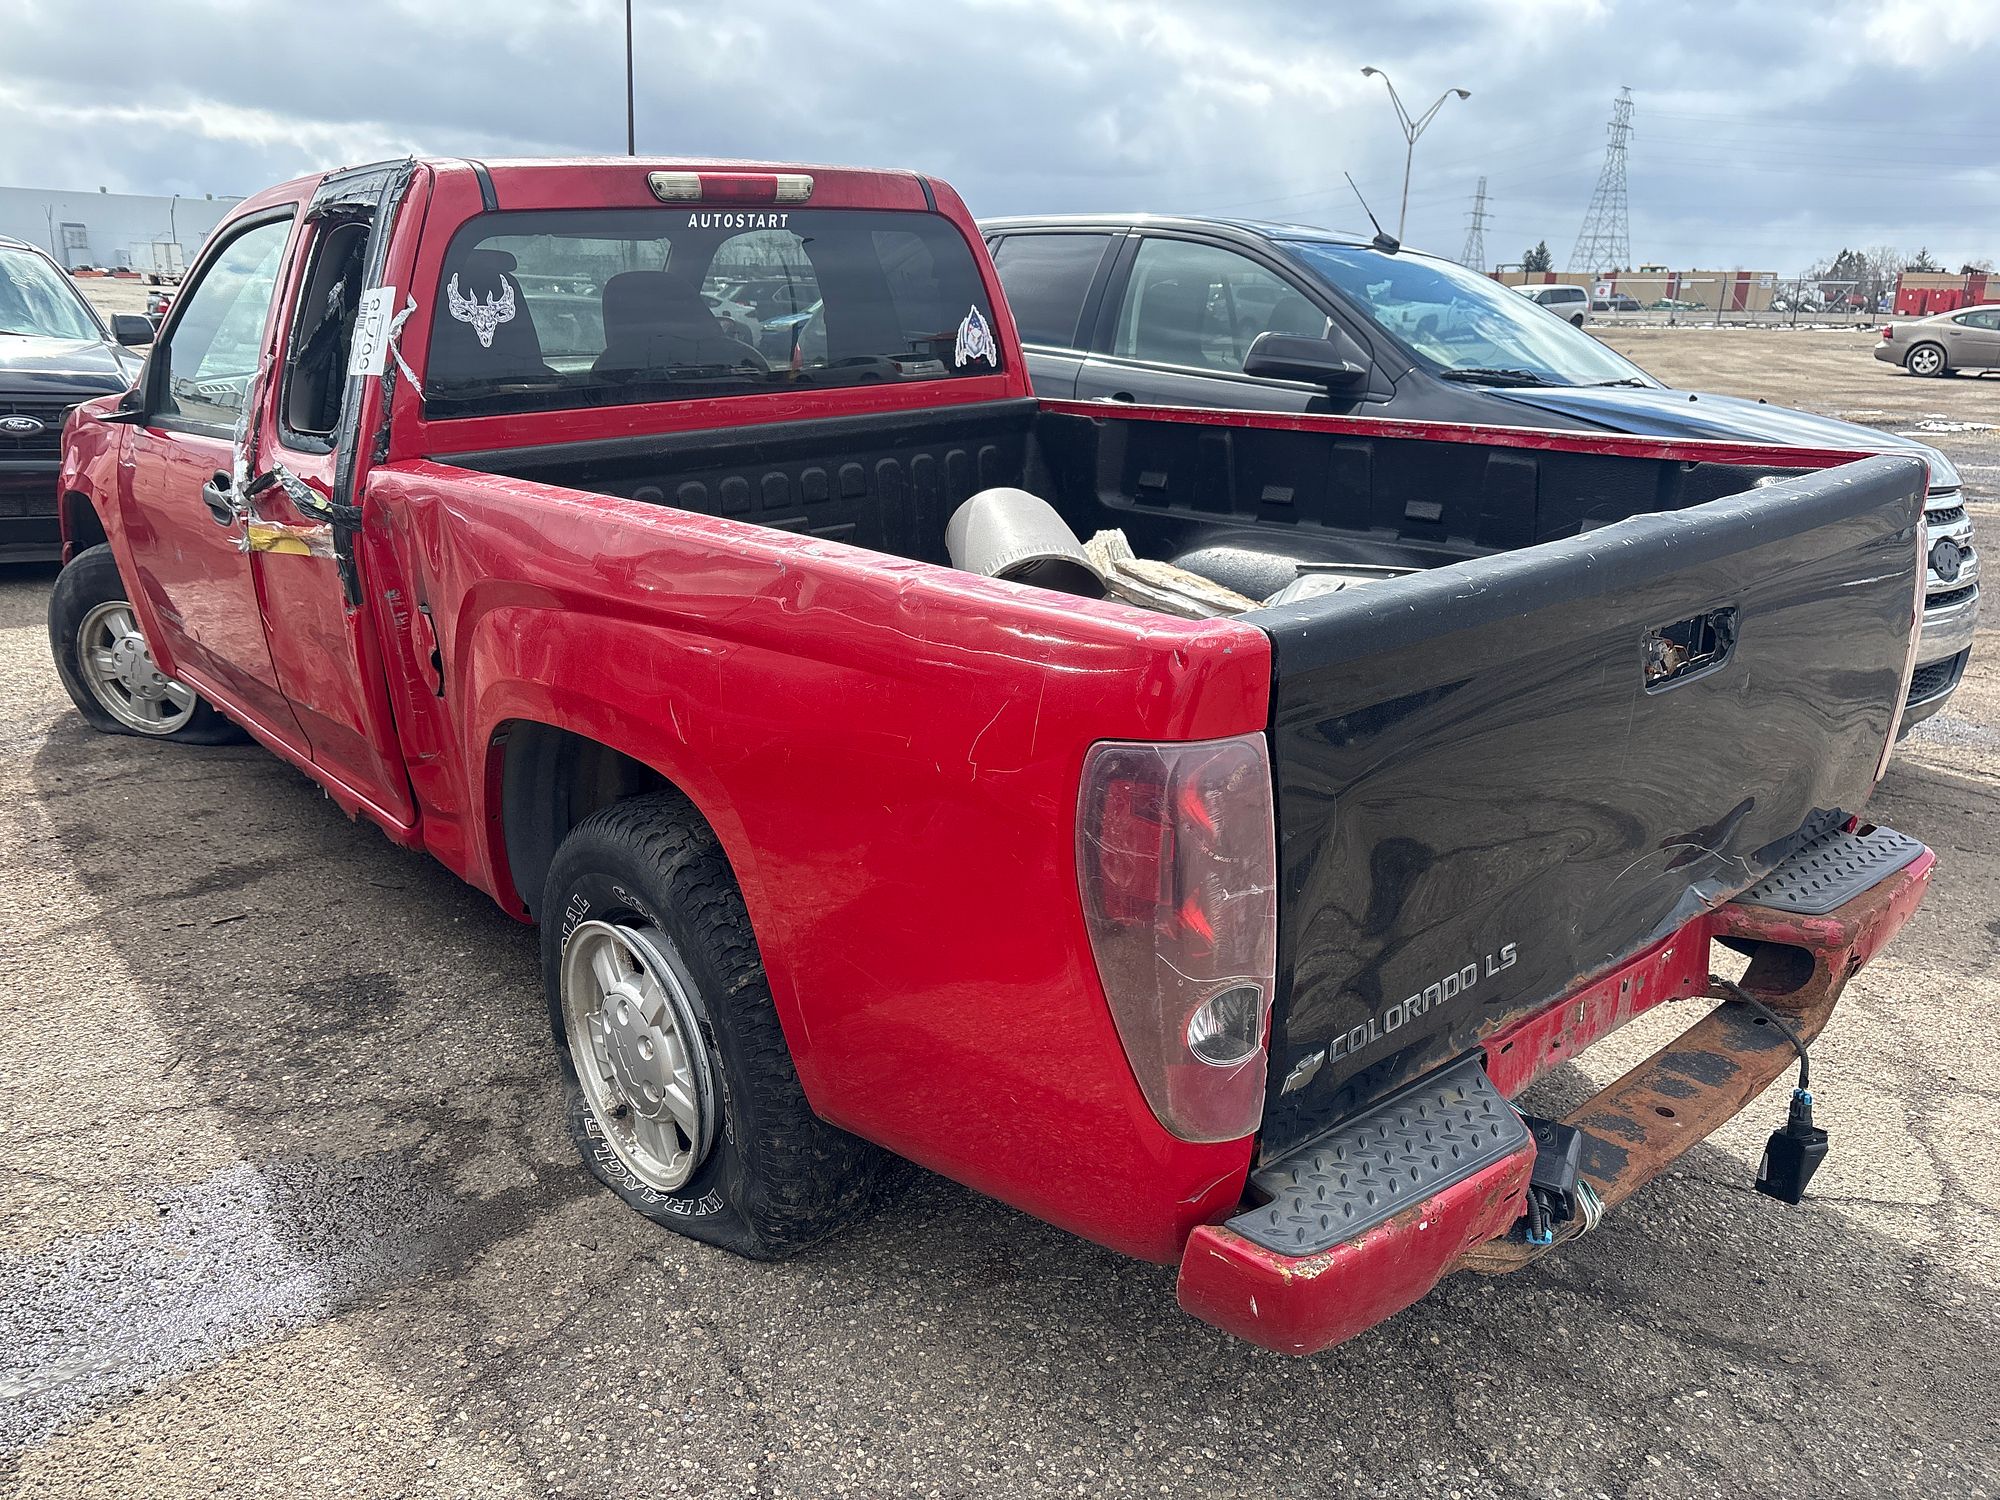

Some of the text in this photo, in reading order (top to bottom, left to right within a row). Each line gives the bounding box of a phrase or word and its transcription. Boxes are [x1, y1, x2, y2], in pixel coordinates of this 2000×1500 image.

[687, 213, 789, 228] AUTOSTART
[1329, 942, 1518, 1064] COLORADO LS
